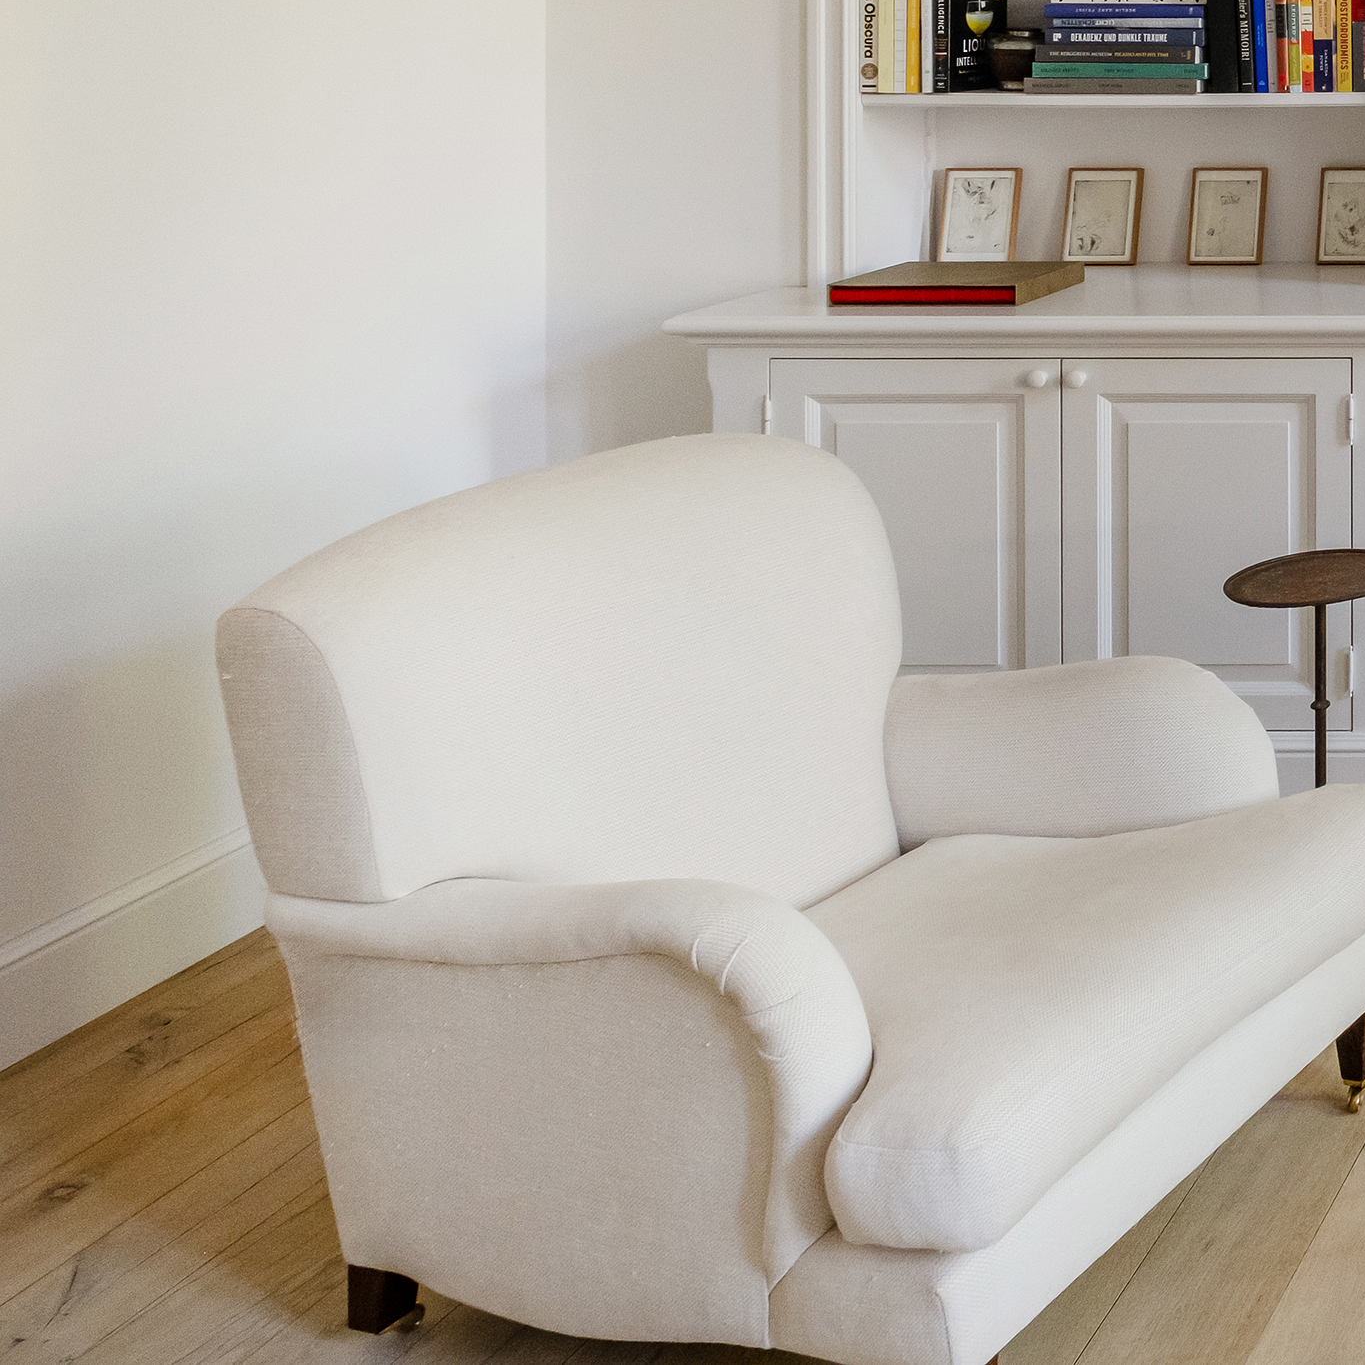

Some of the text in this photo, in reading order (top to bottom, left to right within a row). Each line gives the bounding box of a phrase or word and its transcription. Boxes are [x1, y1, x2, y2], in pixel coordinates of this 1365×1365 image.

[864, 3, 876, 59] Obscura
[1070, 33, 1141, 42] DEKADENZ UND DUNKLE
[1240, 21, 1250, 61] MEMOIR!
